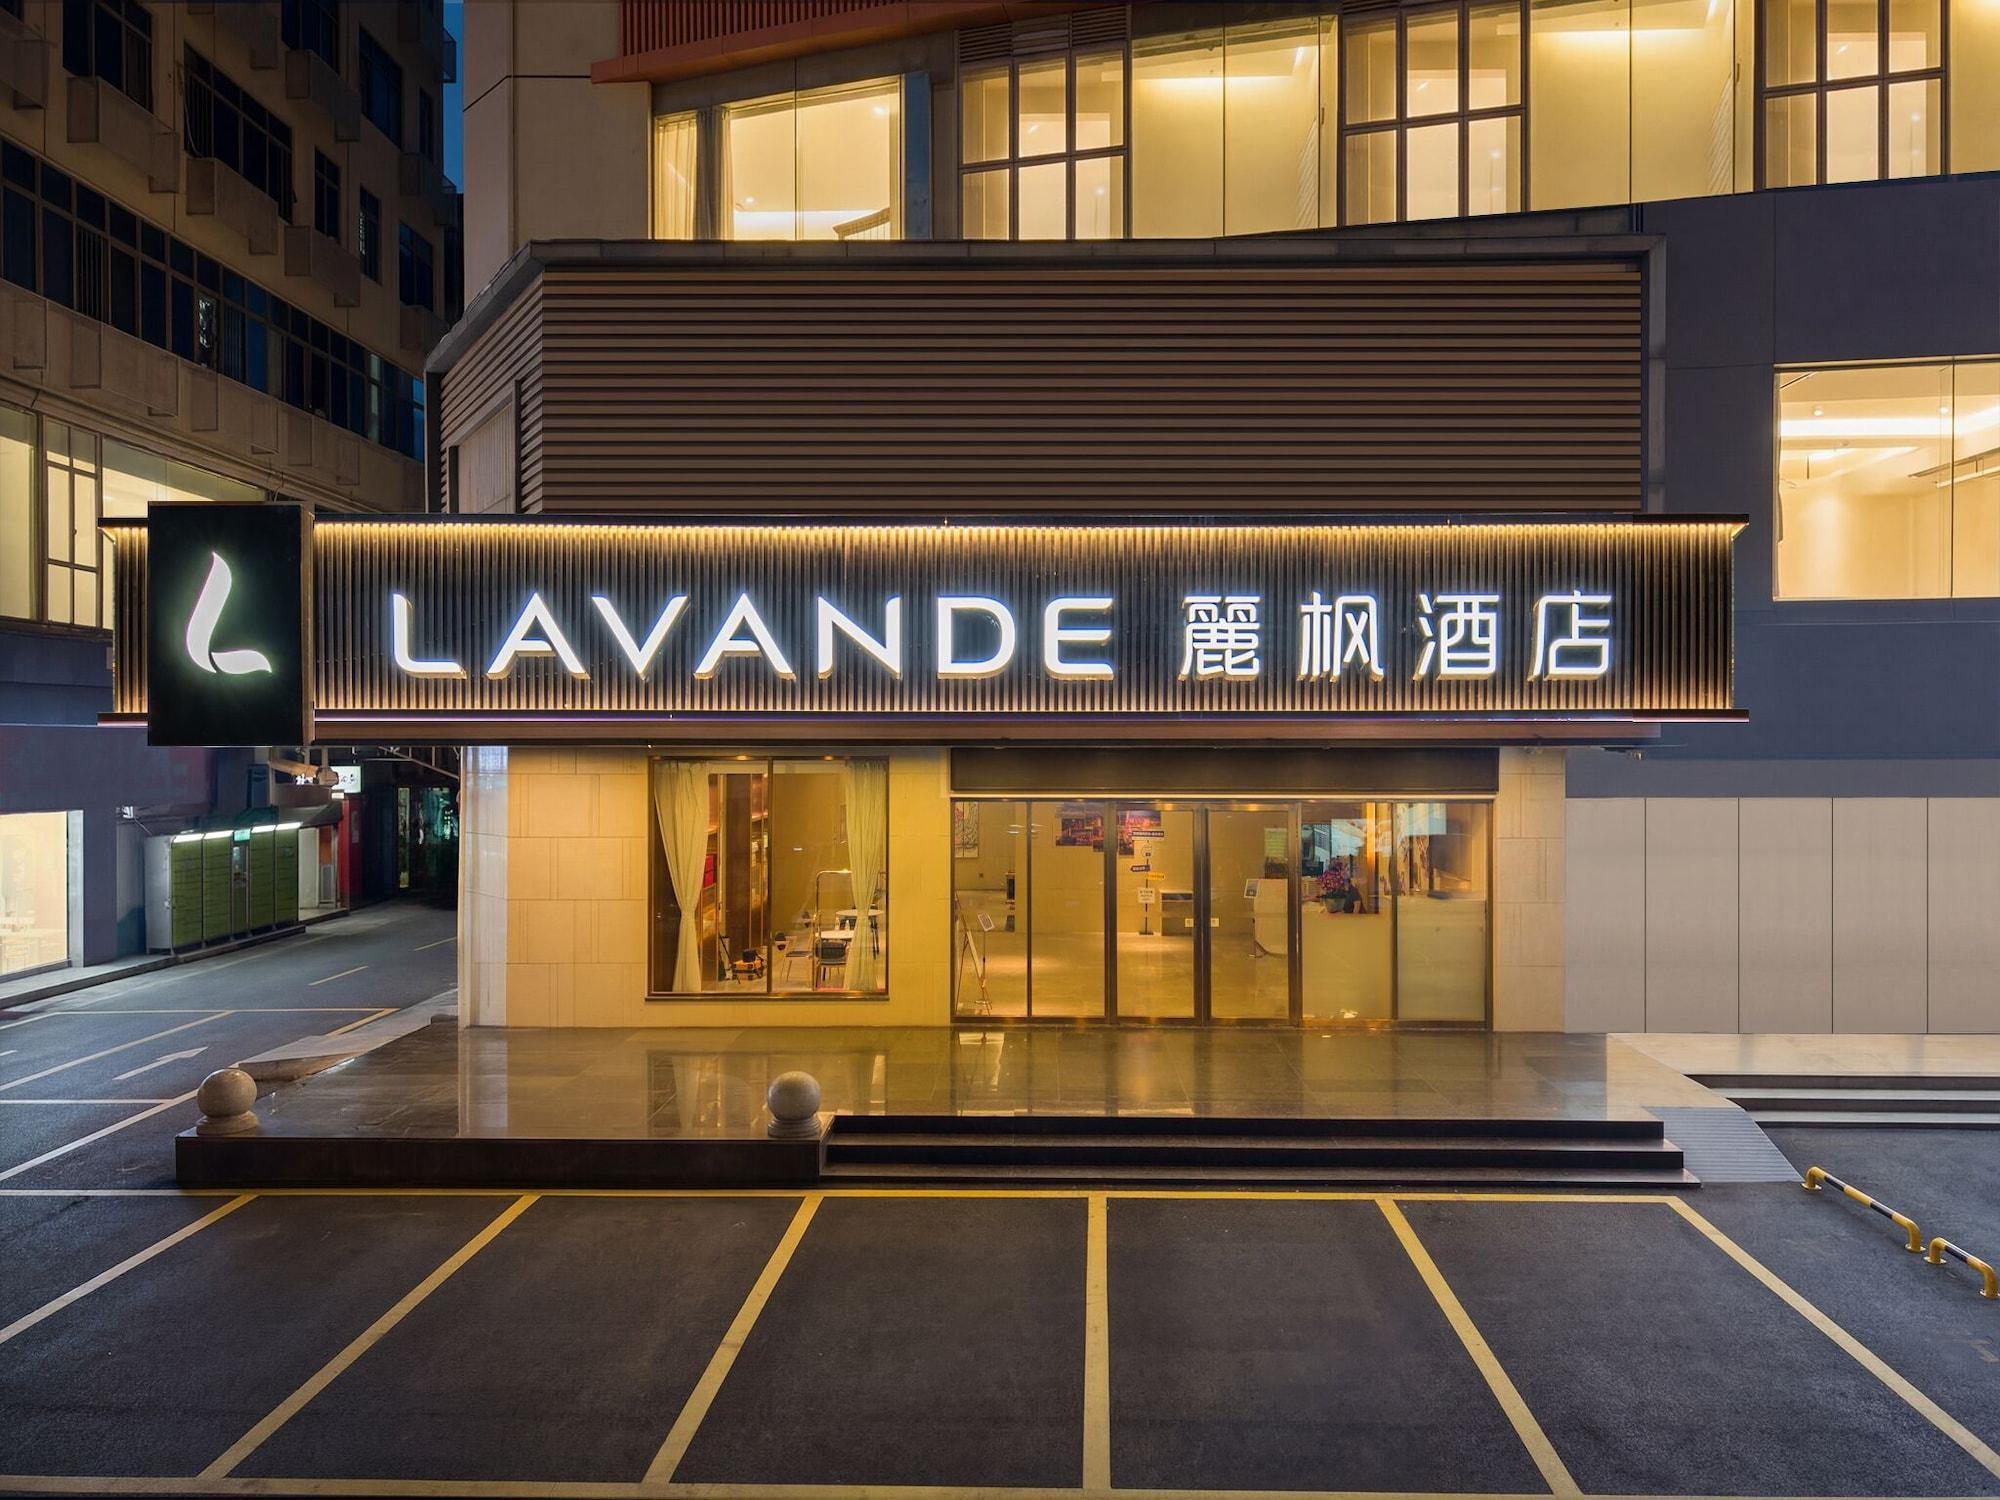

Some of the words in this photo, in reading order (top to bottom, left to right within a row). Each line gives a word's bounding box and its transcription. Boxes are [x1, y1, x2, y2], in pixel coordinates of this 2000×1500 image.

[390, 592, 1115, 680] LAVANDE
[1180, 590, 1613, 681] 麗枫酒店
